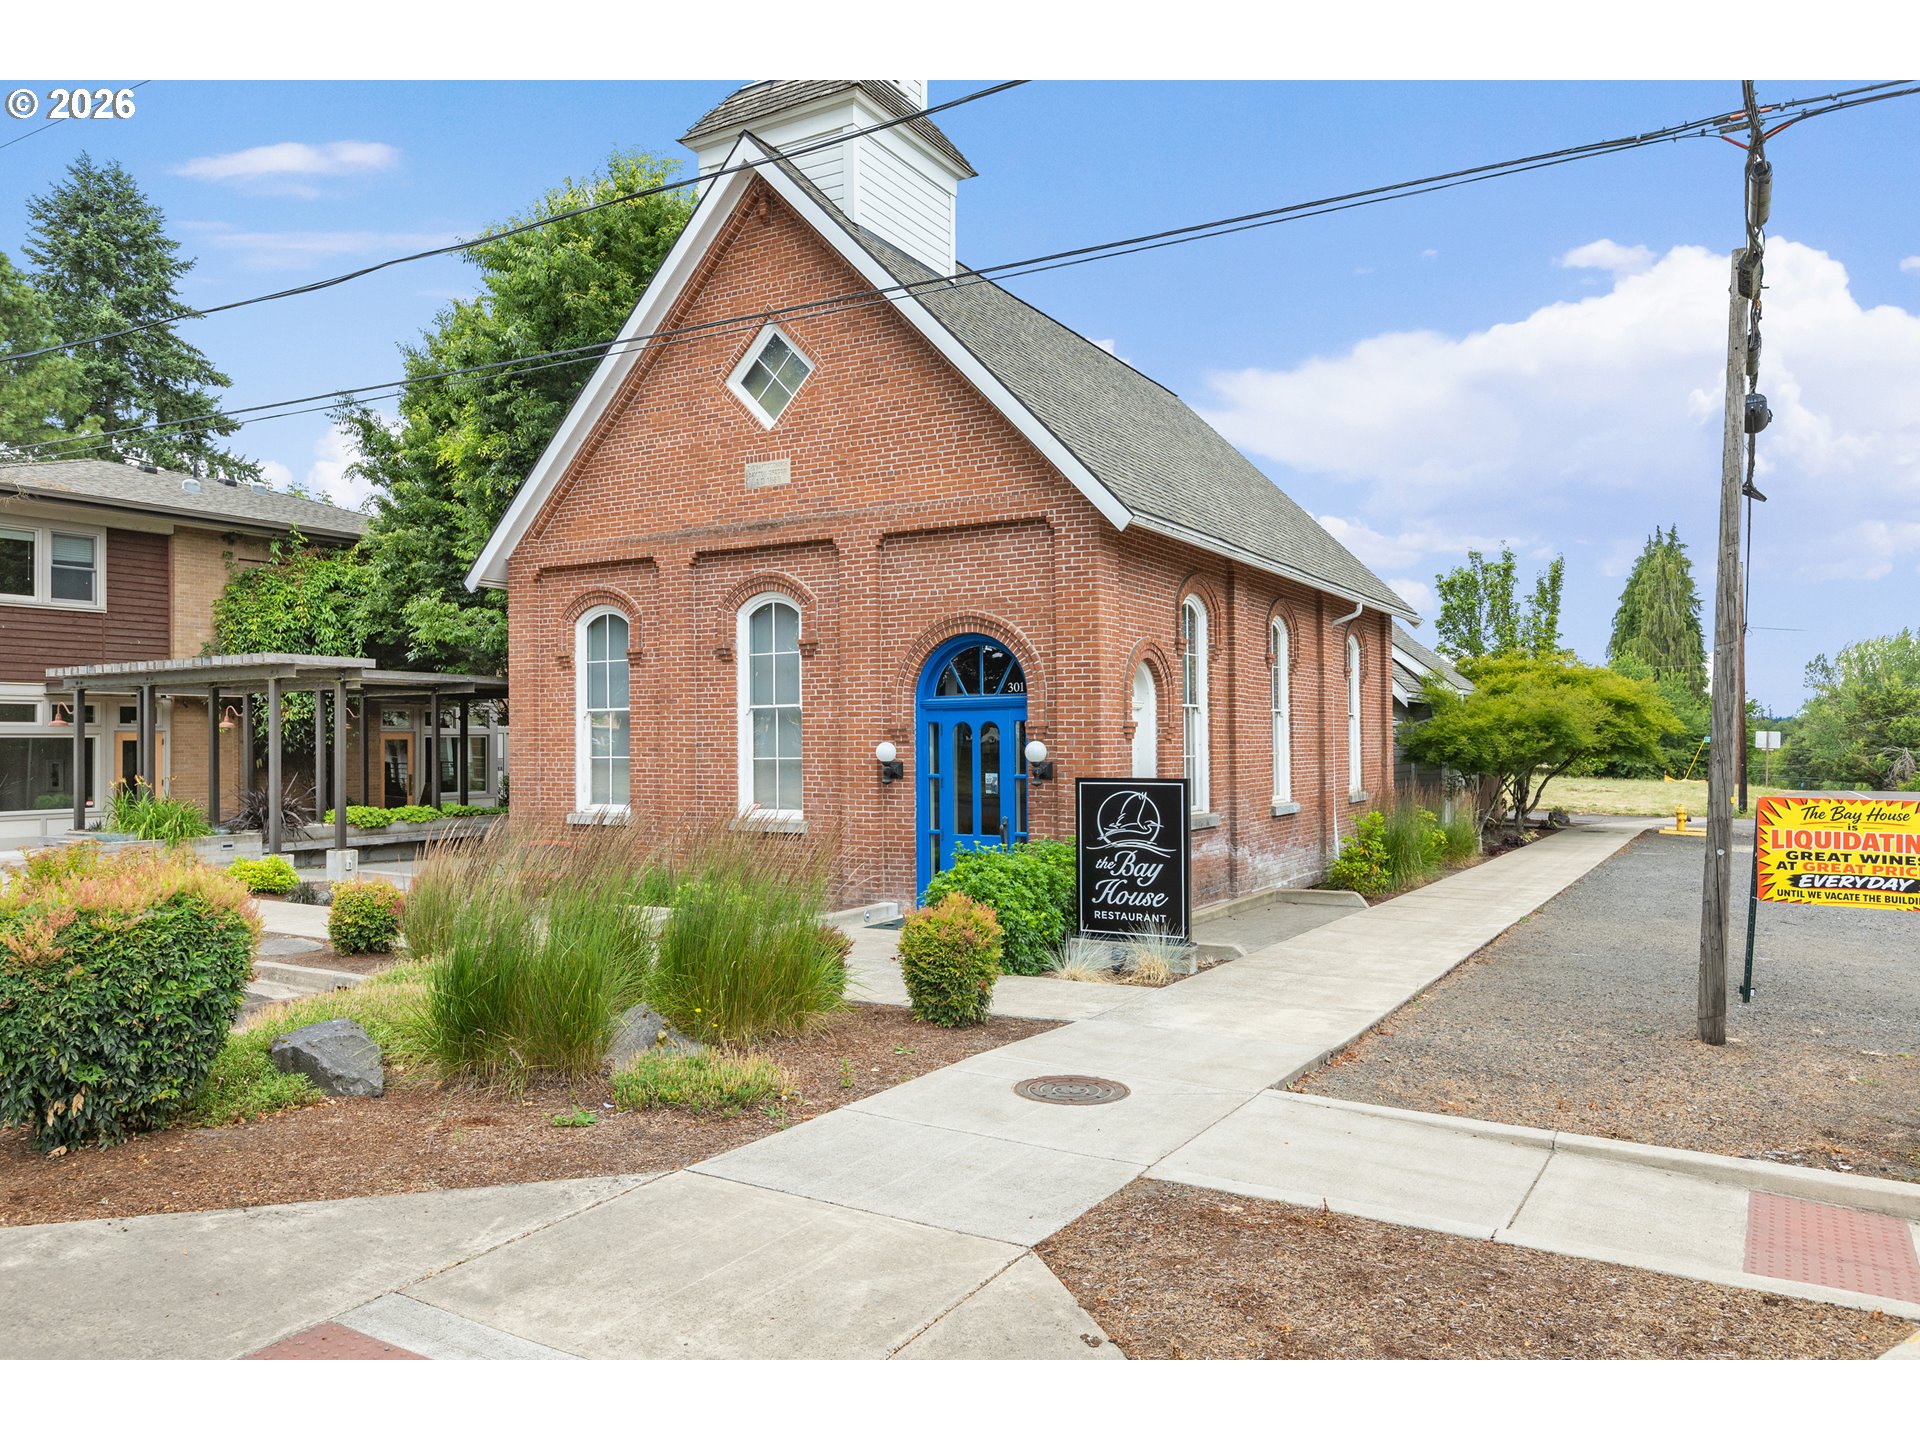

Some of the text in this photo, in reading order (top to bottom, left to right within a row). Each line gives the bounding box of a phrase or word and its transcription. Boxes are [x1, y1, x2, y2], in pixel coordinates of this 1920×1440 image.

[1007, 682, 1024, 692] 301
[1801, 806, 1911, 824] The Bay House
[1848, 823, 1858, 831] is
[1771, 829, 1920, 854] LIQUIDATIN
[1786, 850, 1920, 866] GREAT WINE
[1095, 850, 1164, 887] the Bay
[1776, 861, 1920, 877] AT GREAT PRIC
[1798, 874, 1915, 892] EVERYDAY
[1091, 878, 1169, 908] House
[1777, 889, 1920, 906] UNTIL WE VACATE THE BUILDI
[1094, 910, 1167, 923] RESTAURANT
